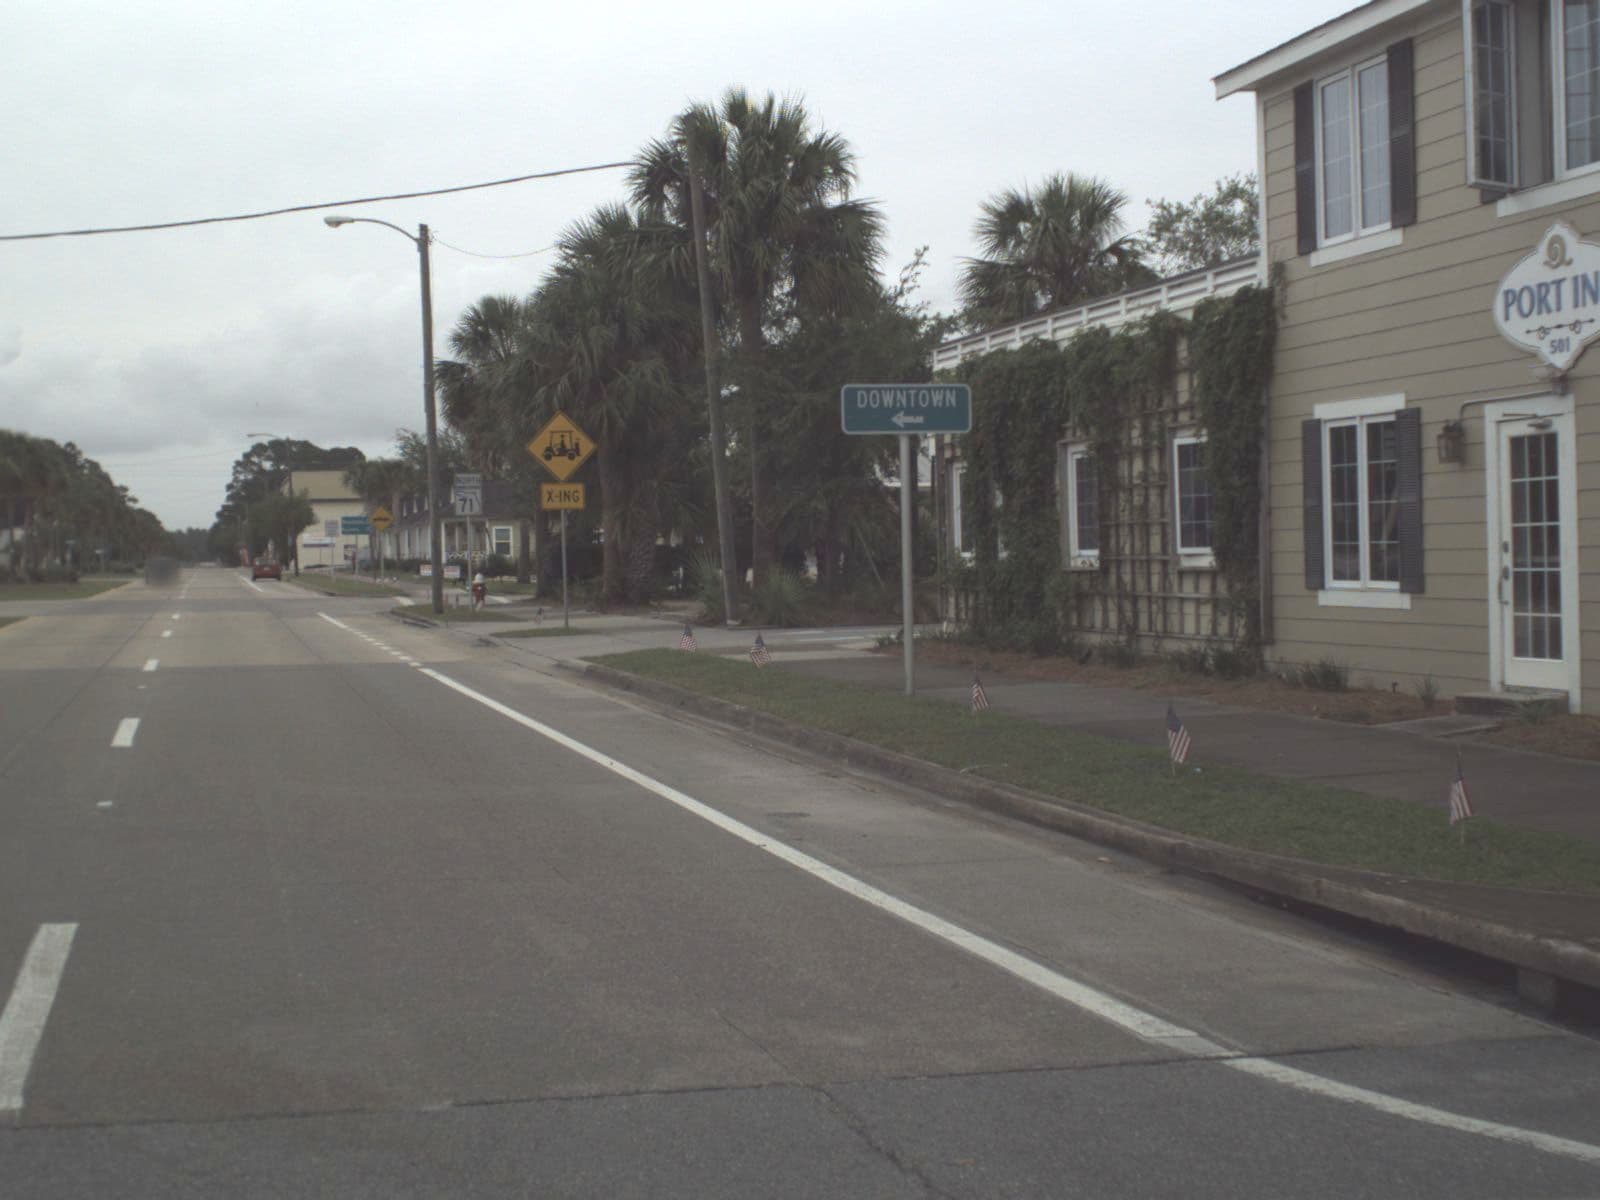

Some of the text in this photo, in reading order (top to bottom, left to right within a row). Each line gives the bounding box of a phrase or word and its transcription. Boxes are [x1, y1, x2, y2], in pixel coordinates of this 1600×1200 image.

[1503, 278, 1567, 321] PORT
[857, 389, 956, 408] DOWNTOWN
[545, 490, 580, 503] X-ING
[459, 498, 473, 512] 71
